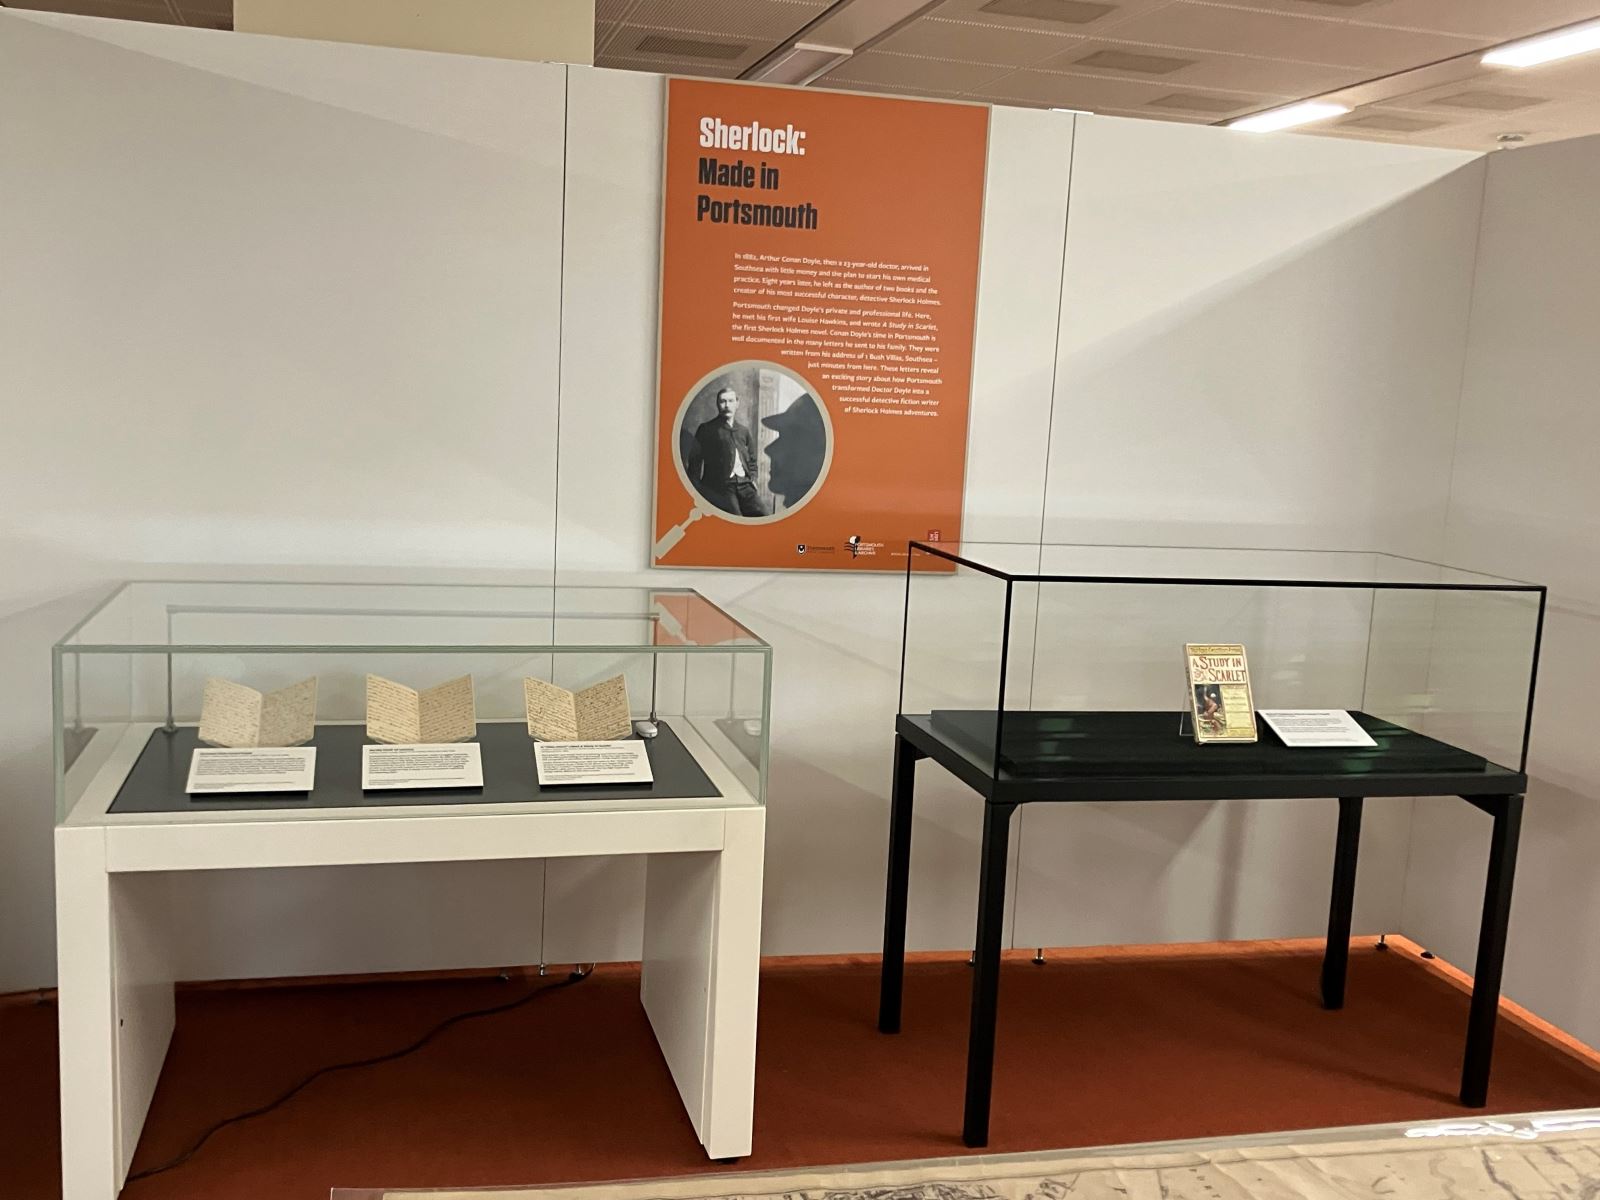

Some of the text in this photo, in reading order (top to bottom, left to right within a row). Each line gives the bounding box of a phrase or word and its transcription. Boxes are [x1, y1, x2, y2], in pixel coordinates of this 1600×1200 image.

[700, 117, 806, 155] Sherlock:
[698, 157, 778, 190] Made in
[697, 195, 818, 230] Portsmouth
[760, 254, 780, 262] Arthur
[803, 258, 821, 266] Doyle,
[734, 264, 764, 272] Southsea
[762, 278, 778, 286] Eight
[862, 310, 900, 318] professional
[1193, 658, 1199, 668] A
[1232, 658, 1242, 668] IN
[1208, 668, 1246, 682] SCARLET
